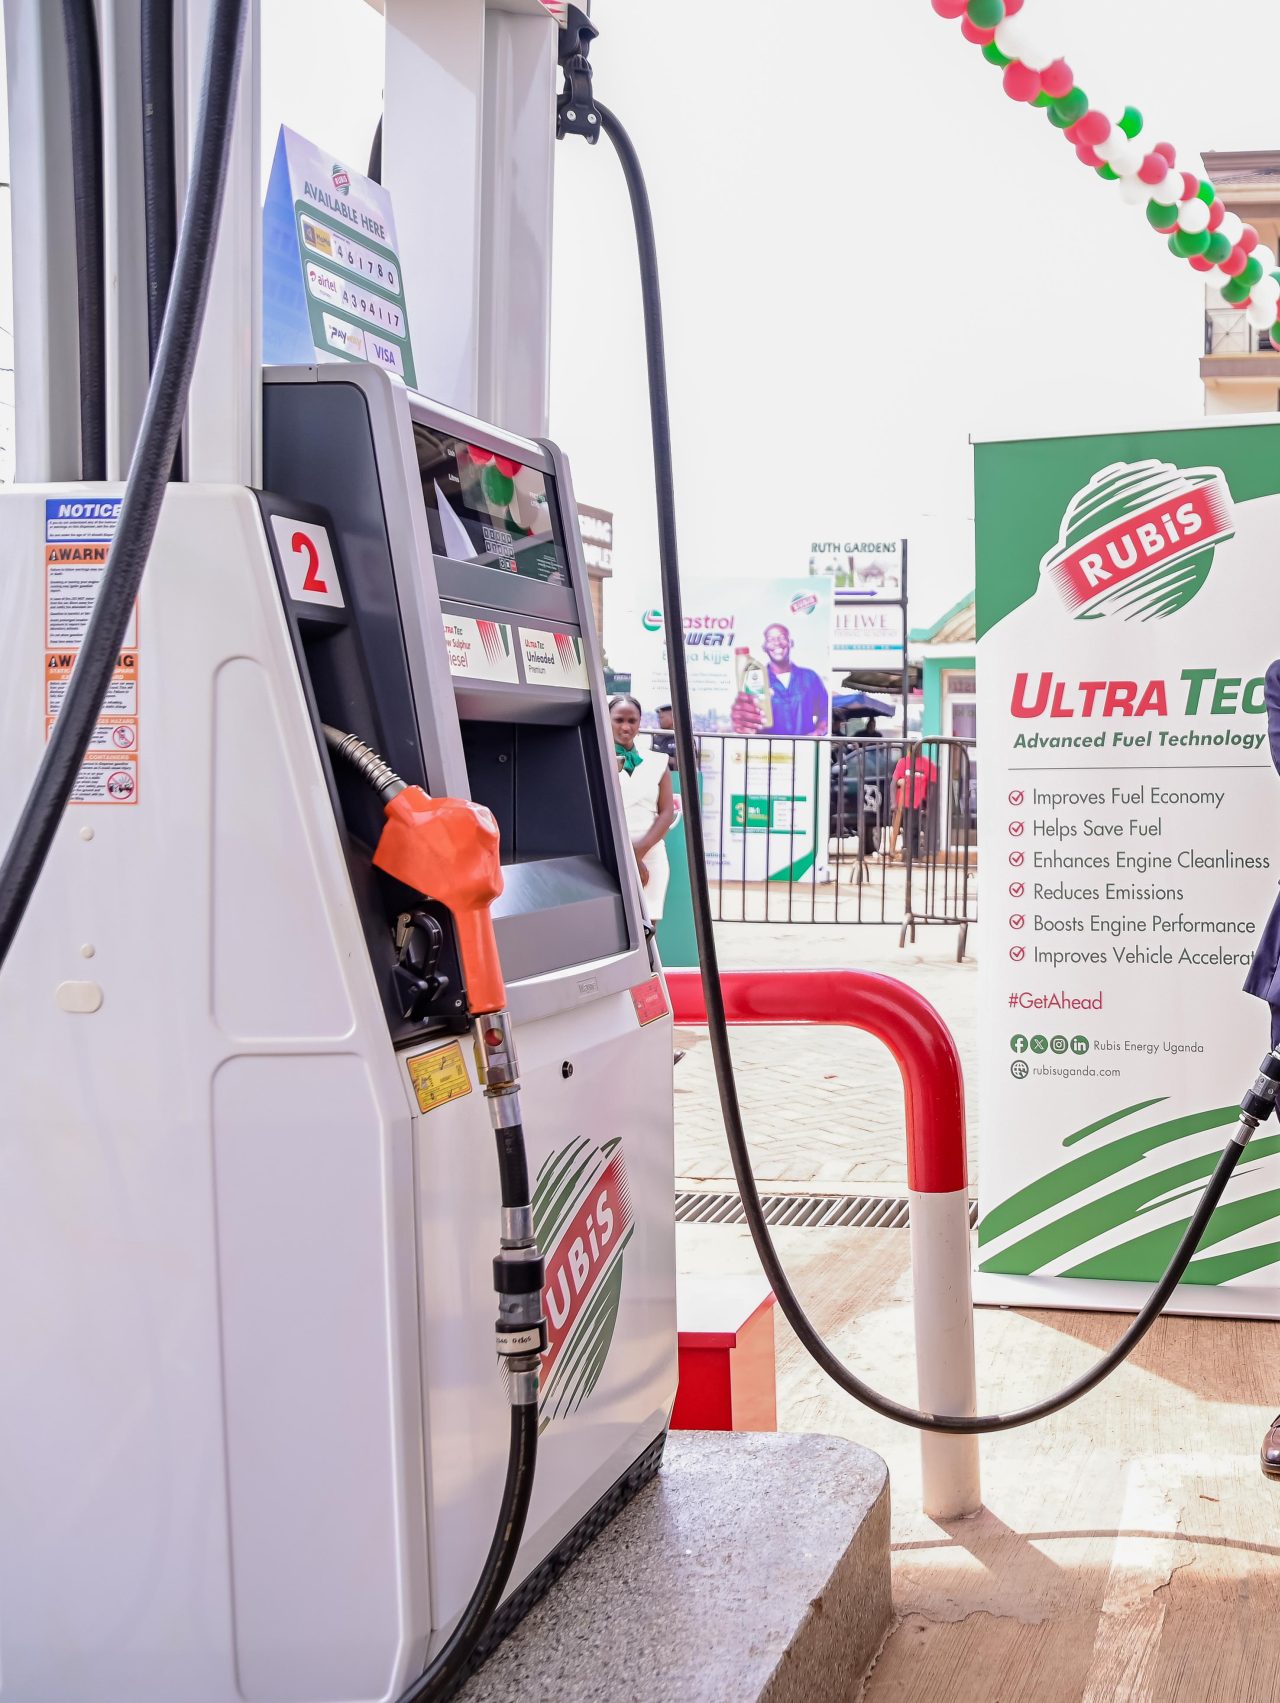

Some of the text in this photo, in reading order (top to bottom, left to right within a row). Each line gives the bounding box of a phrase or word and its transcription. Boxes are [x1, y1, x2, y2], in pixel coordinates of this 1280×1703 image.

[304, 181, 386, 240] AVAILABLE HERE
[317, 275, 337, 293] airtel
[374, 344, 396, 365] VISA
[59, 503, 122, 518] NOTICE
[59, 548, 109, 561] WARN
[811, 542, 896, 553] RUTH GARDENS
[291, 531, 328, 593] 2
[682, 615, 735, 629] astrol
[449, 650, 469, 668] iesel
[526, 652, 555, 665] Unleaded
[528, 664, 547, 674] Premium
[1010, 671, 1168, 718] ULTRA
[1013, 729, 1267, 750] Advanced Fuel Technology
[1033, 786, 1225, 810] Improves Fuel Economy
[1033, 817, 1162, 841] Helps Save Fuel
[1033, 850, 1270, 874] Enhances Engine Cleanliness
[1034, 882, 1184, 901] Reduces Emissions
[1034, 913, 1256, 937] Boosts Engine Performance
[1034, 946, 1107, 968] Improves
[1113, 946, 1173, 965] Vehicle
[1008, 991, 1103, 1010] #GetAhead
[1093, 1039, 1204, 1055] Rubis Energy Uganda
[1033, 1064, 1121, 1077] rubisuganda.com
[538, 1190, 615, 1362] UBiS
